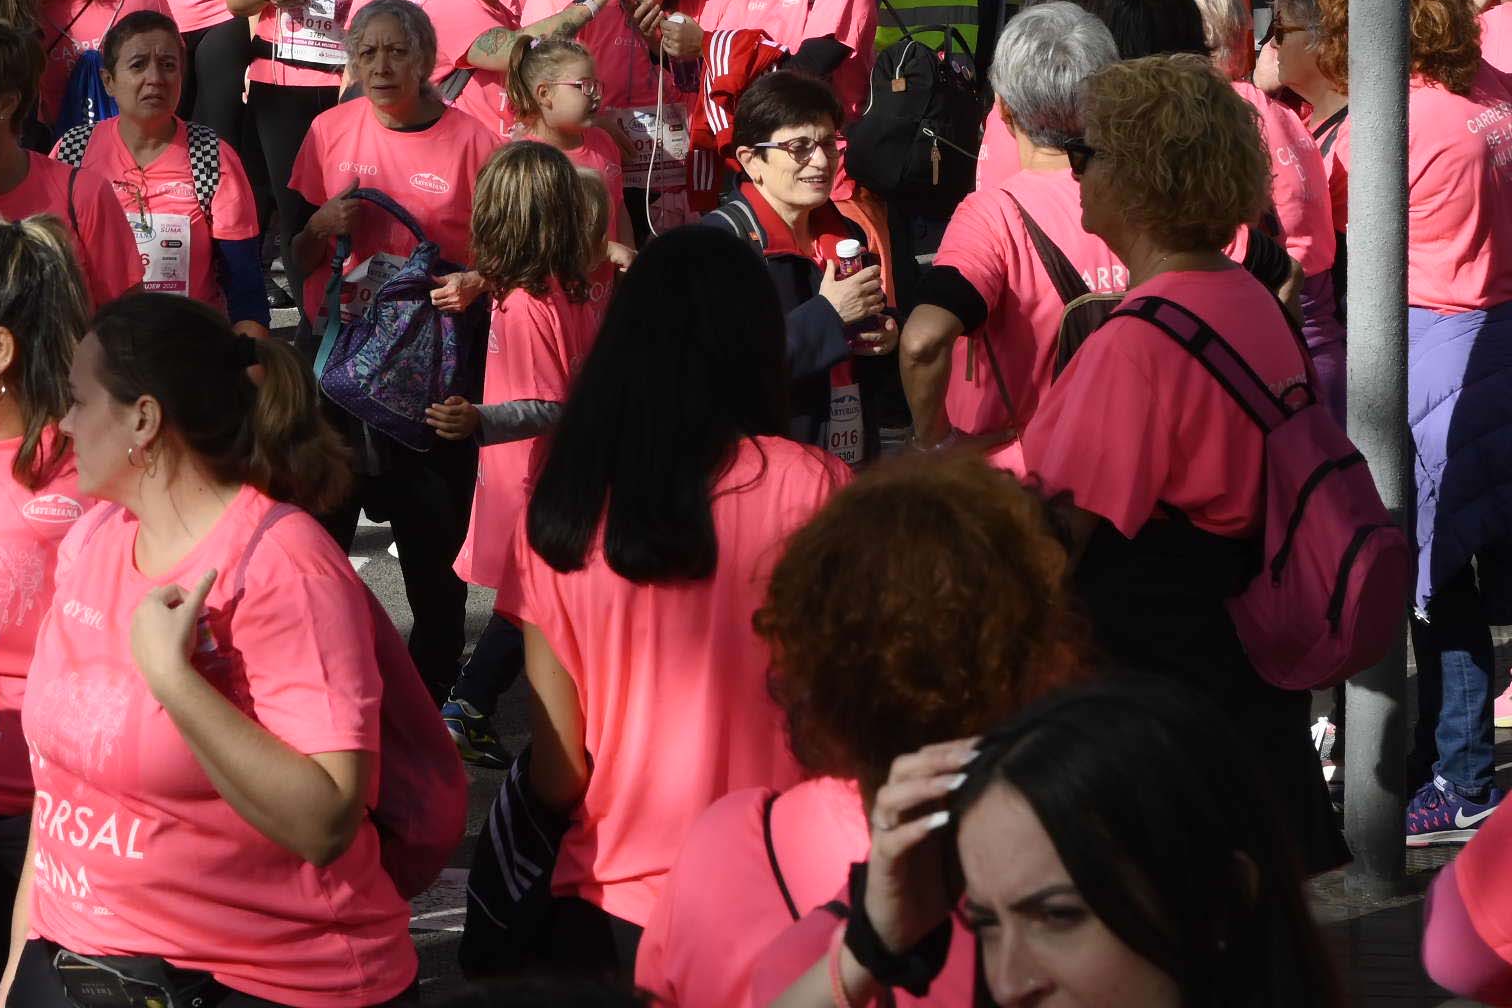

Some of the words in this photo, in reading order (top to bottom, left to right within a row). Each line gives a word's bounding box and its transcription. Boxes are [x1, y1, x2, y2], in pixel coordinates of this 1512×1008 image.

[339, 161, 377, 176] OYSHO
[1081, 265, 1130, 292] ARR
[830, 431, 859, 448] 016
[27, 504, 81, 520] ASTURIANA
[34, 790, 145, 861] ORSAL
